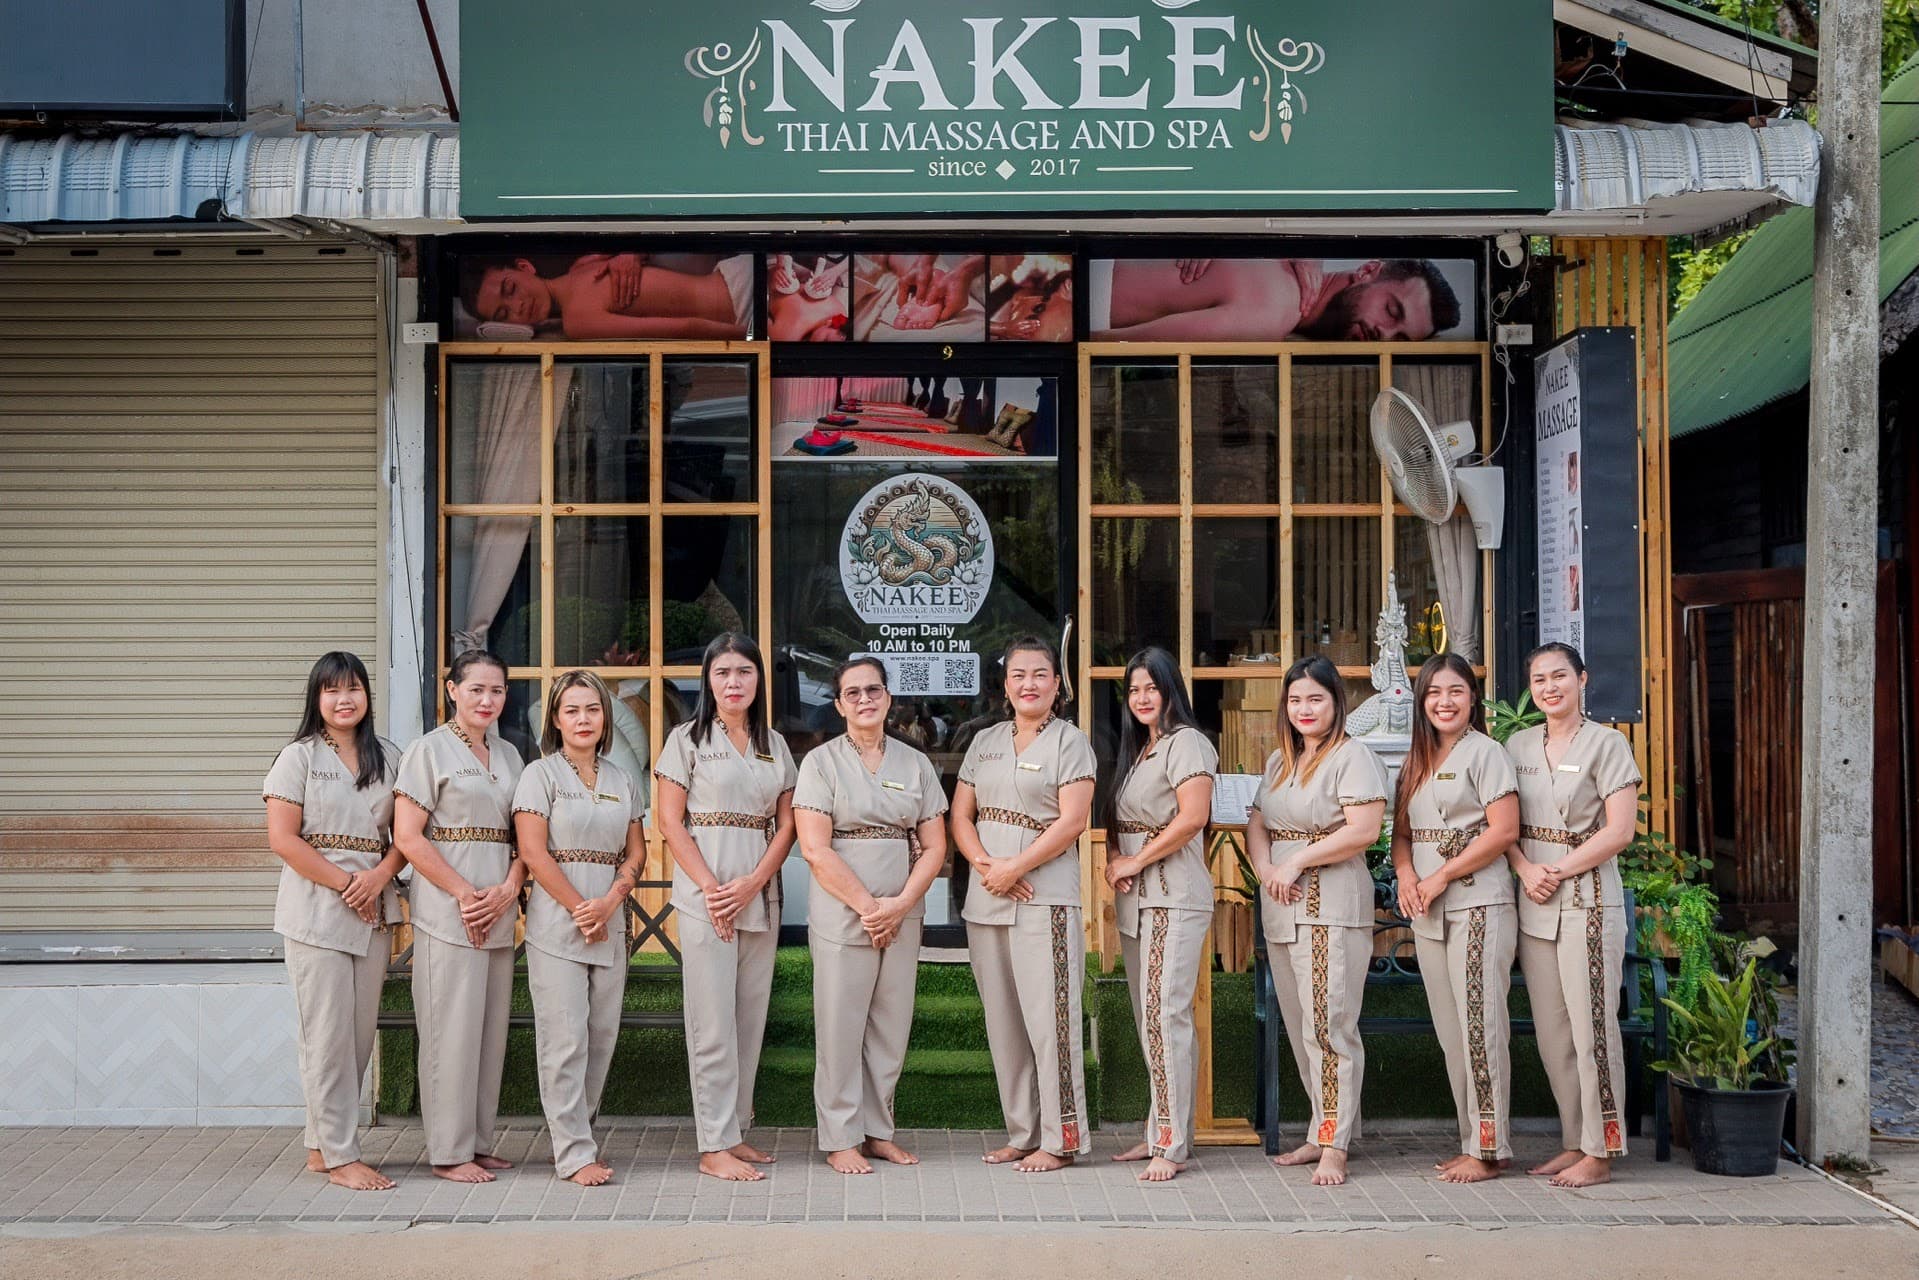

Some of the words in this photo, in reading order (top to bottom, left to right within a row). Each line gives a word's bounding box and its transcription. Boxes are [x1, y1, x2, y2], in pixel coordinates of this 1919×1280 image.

[762, 16, 1245, 112] NAKEE
[777, 122, 869, 153] THAI
[880, 120, 1060, 152] MASSAGE
[1070, 120, 1155, 151] AND
[1167, 118, 1233, 150] SPA
[928, 158, 987, 177] since
[1029, 158, 1081, 176] 2017
[943, 345, 953, 360] 9
[1545, 365, 1568, 396] NAKEE
[1538, 396, 1578, 441] MASSAGE
[869, 587, 963, 606] NAKEE
[872, 606, 890, 614] THAI
[892, 606, 929, 614] MASSAGE
[930, 606, 946, 614] AND
[948, 606, 962, 614] SPA
[879, 624, 917, 639] Open
[920, 624, 955, 639] Daily
[867, 640, 881, 652] 10
[884, 640, 908, 652] AM
[911, 640, 925, 652] to
[929, 640, 944, 652] 10
[949, 640, 970, 652] PM
[701, 751, 730, 761] NAKEE
[311, 769, 342, 780] NAKEE
[557, 787, 584, 800] NAKEE
